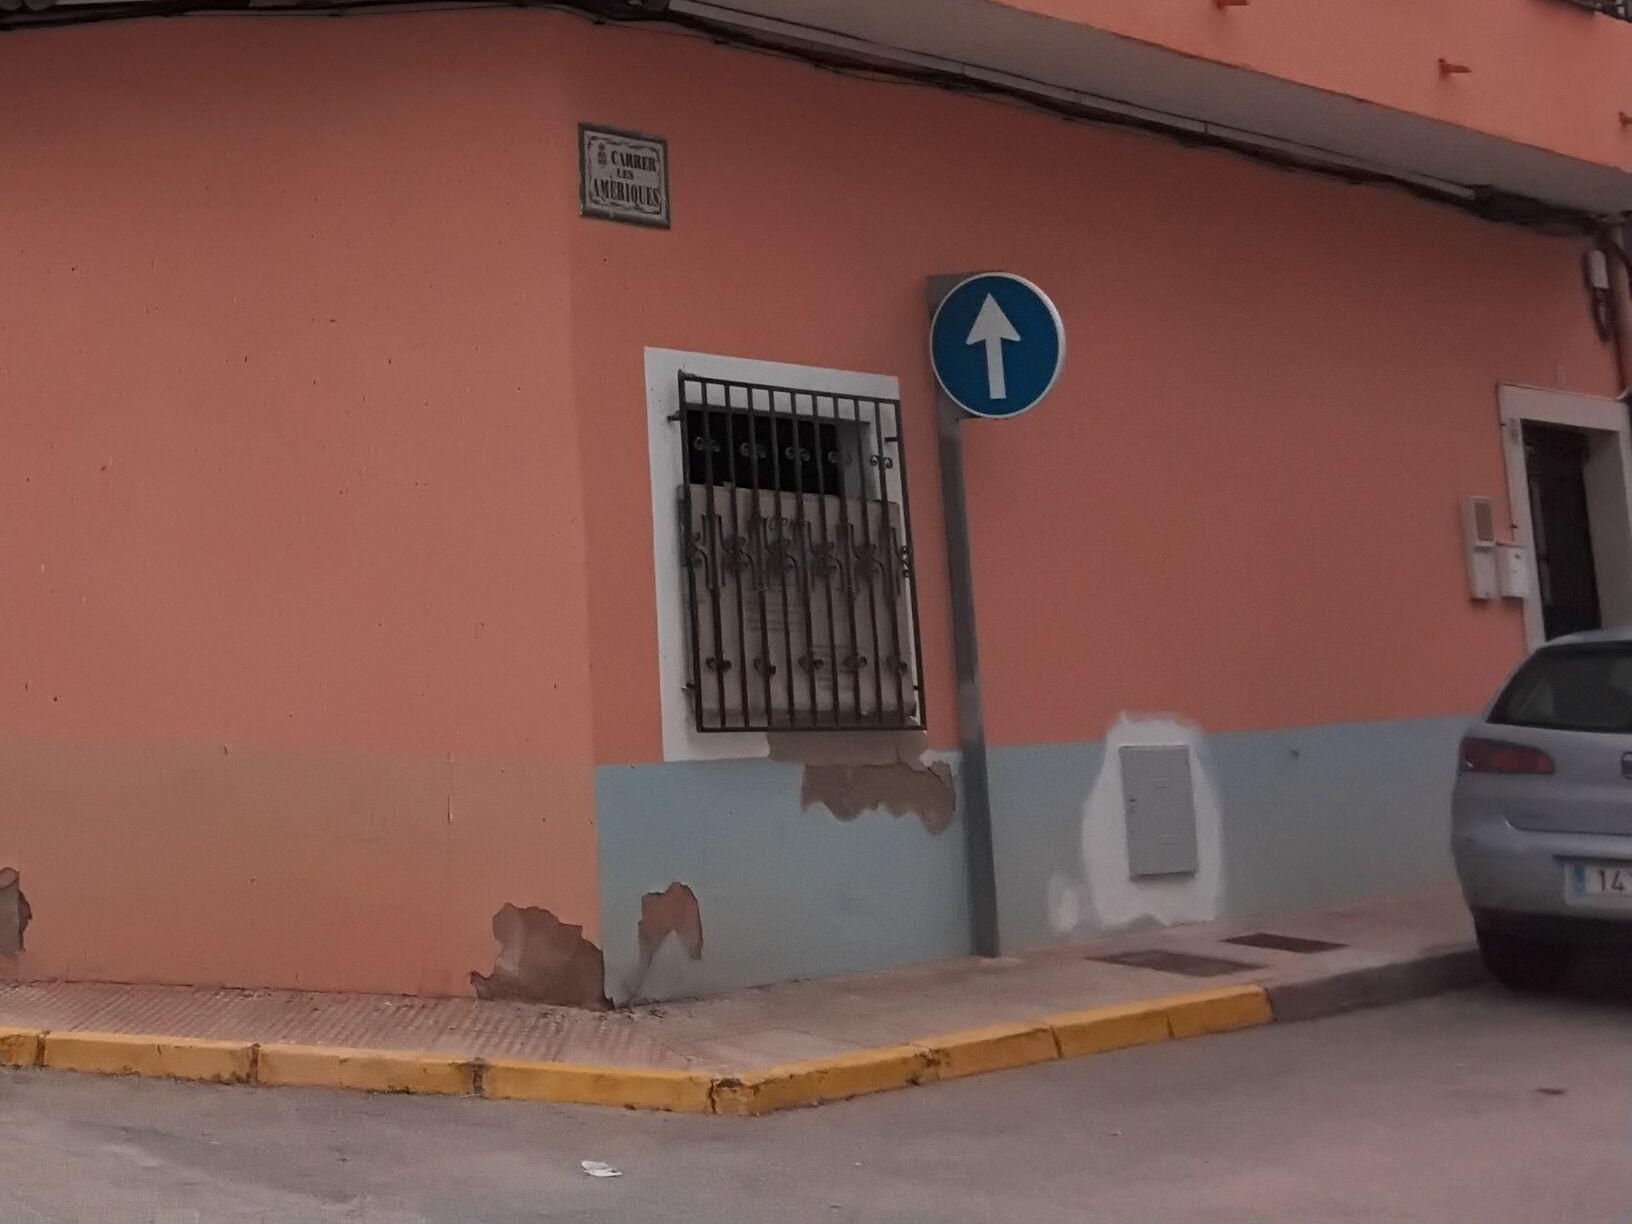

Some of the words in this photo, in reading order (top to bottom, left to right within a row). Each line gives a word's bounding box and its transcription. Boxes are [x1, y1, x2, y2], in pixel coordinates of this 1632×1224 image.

[610, 150, 657, 172] CARRER
[616, 168, 634, 180] LES
[1598, 869, 1632, 892] 14
